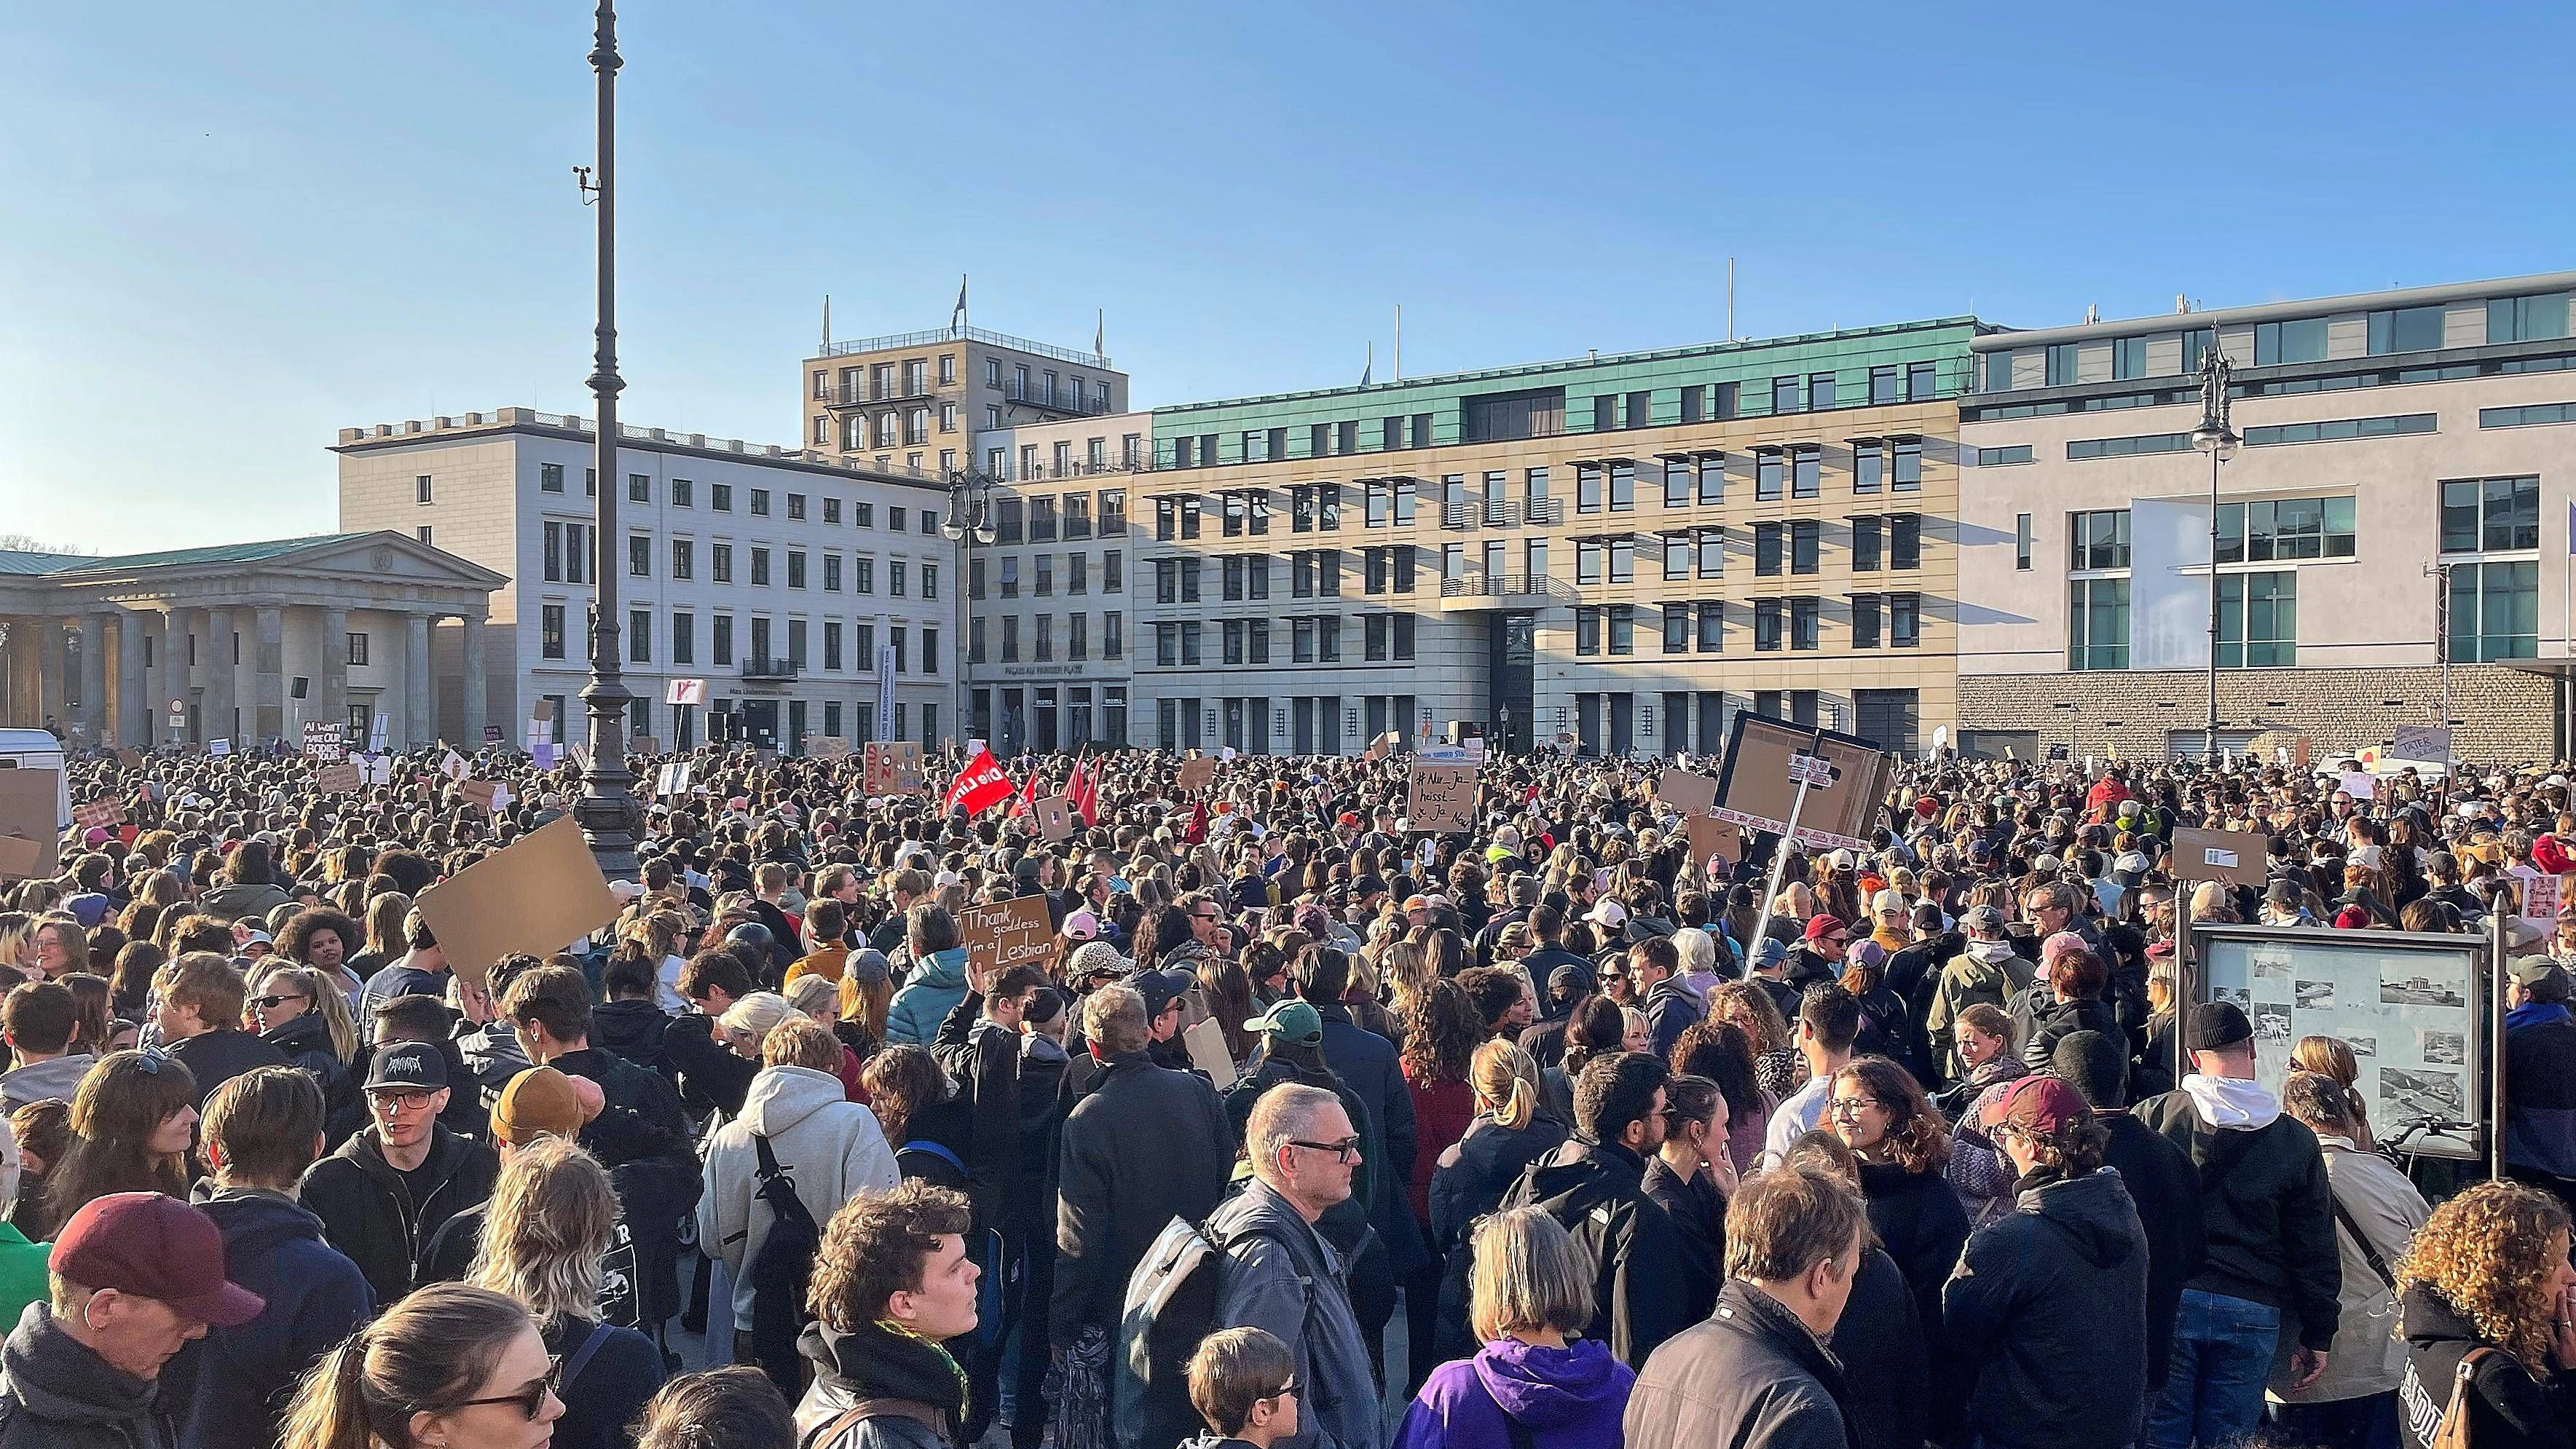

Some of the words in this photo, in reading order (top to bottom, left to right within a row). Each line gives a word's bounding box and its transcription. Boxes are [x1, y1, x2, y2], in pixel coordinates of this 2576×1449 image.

[304, 722, 315, 732] AI
[323, 733, 341, 743] OUR
[307, 743, 340, 754] BODIES
[1429, 805, 1446, 821] Ja
[961, 904, 1012, 930] Thank
[993, 917, 1040, 938] goddess
[968, 939, 984, 953] I'm
[988, 941, 996, 949] a
[996, 931, 1052, 964] Lesbian
